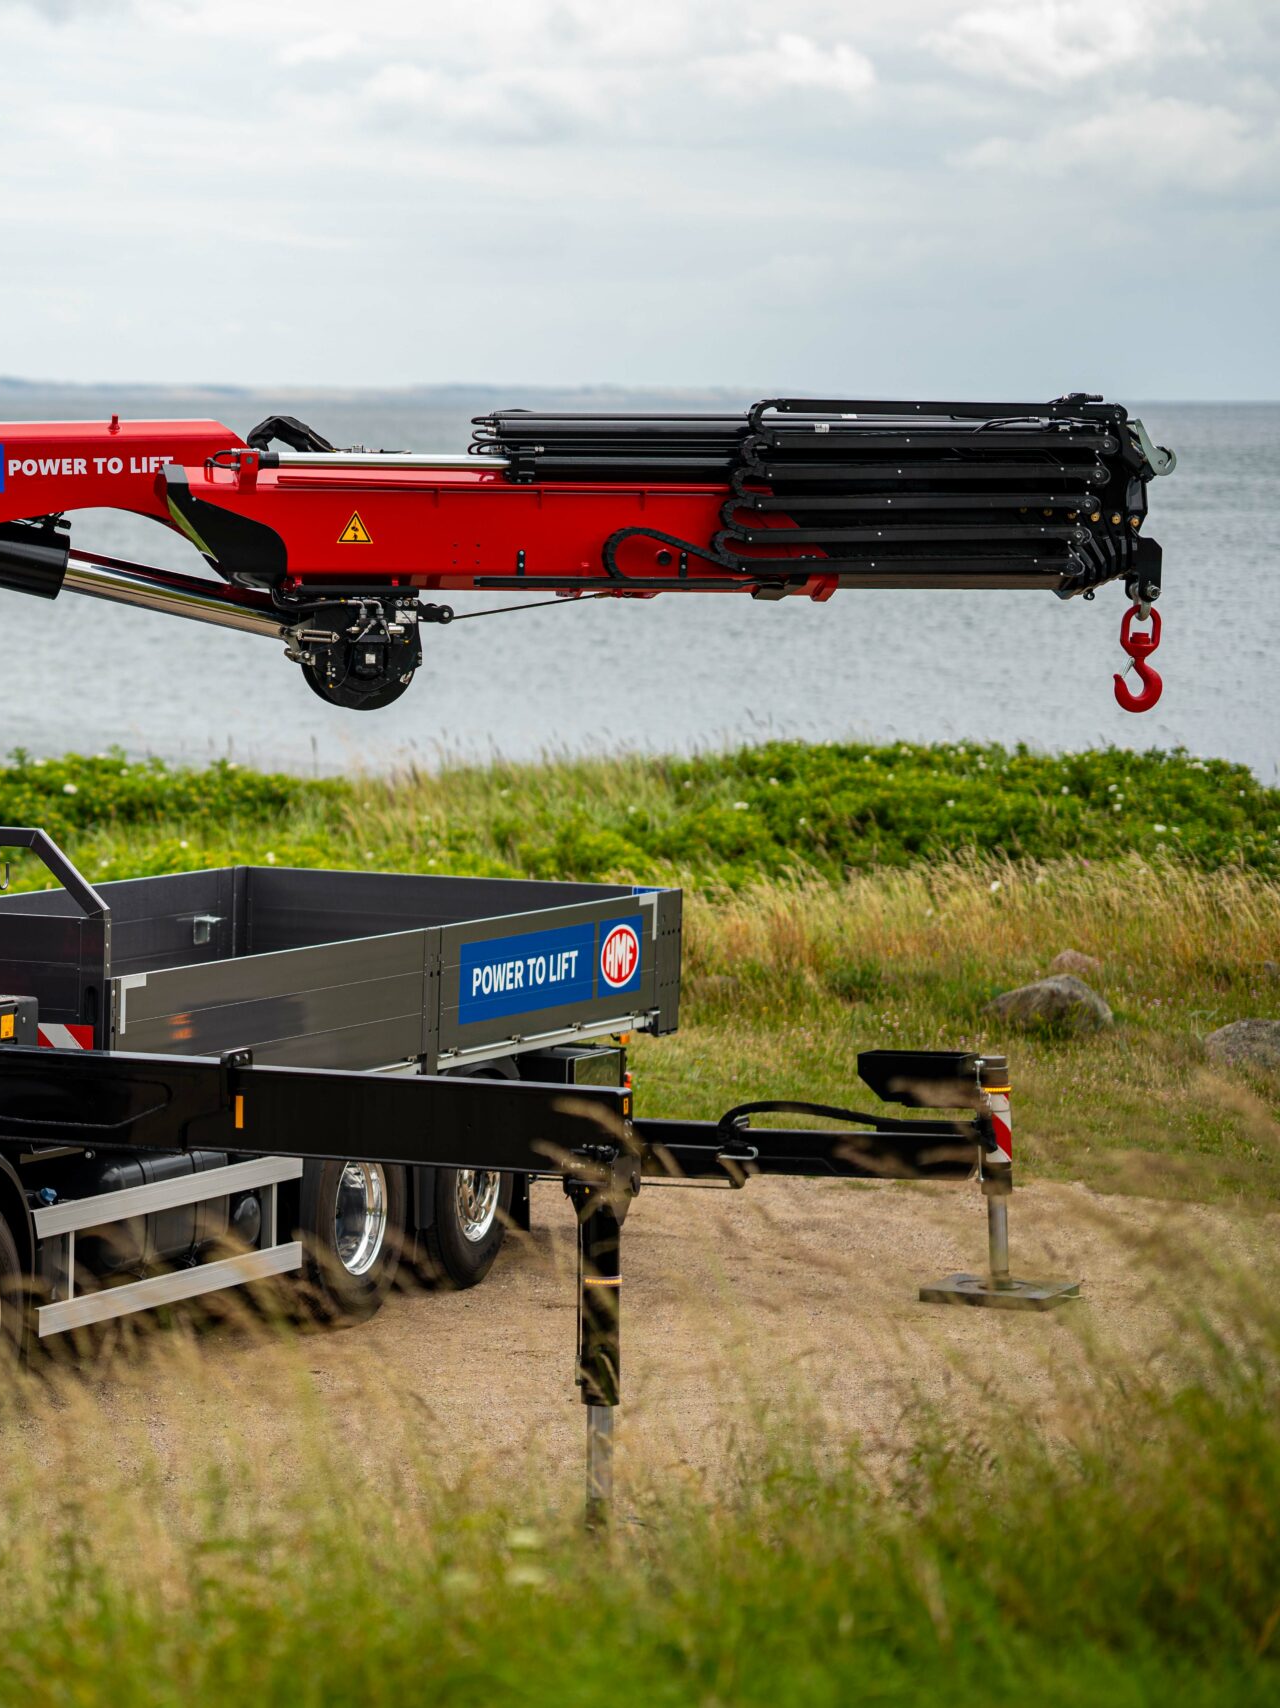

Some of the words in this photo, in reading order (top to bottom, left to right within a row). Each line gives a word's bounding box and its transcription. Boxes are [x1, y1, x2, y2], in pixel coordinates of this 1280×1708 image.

[8, 458, 87, 476] POWER
[93, 457, 124, 474] TO
[130, 456, 174, 473] LIFT
[472, 959, 524, 997] POWER
[527, 956, 546, 986] TO
[549, 950, 579, 982] LIFT
[606, 933, 635, 980] HMF
